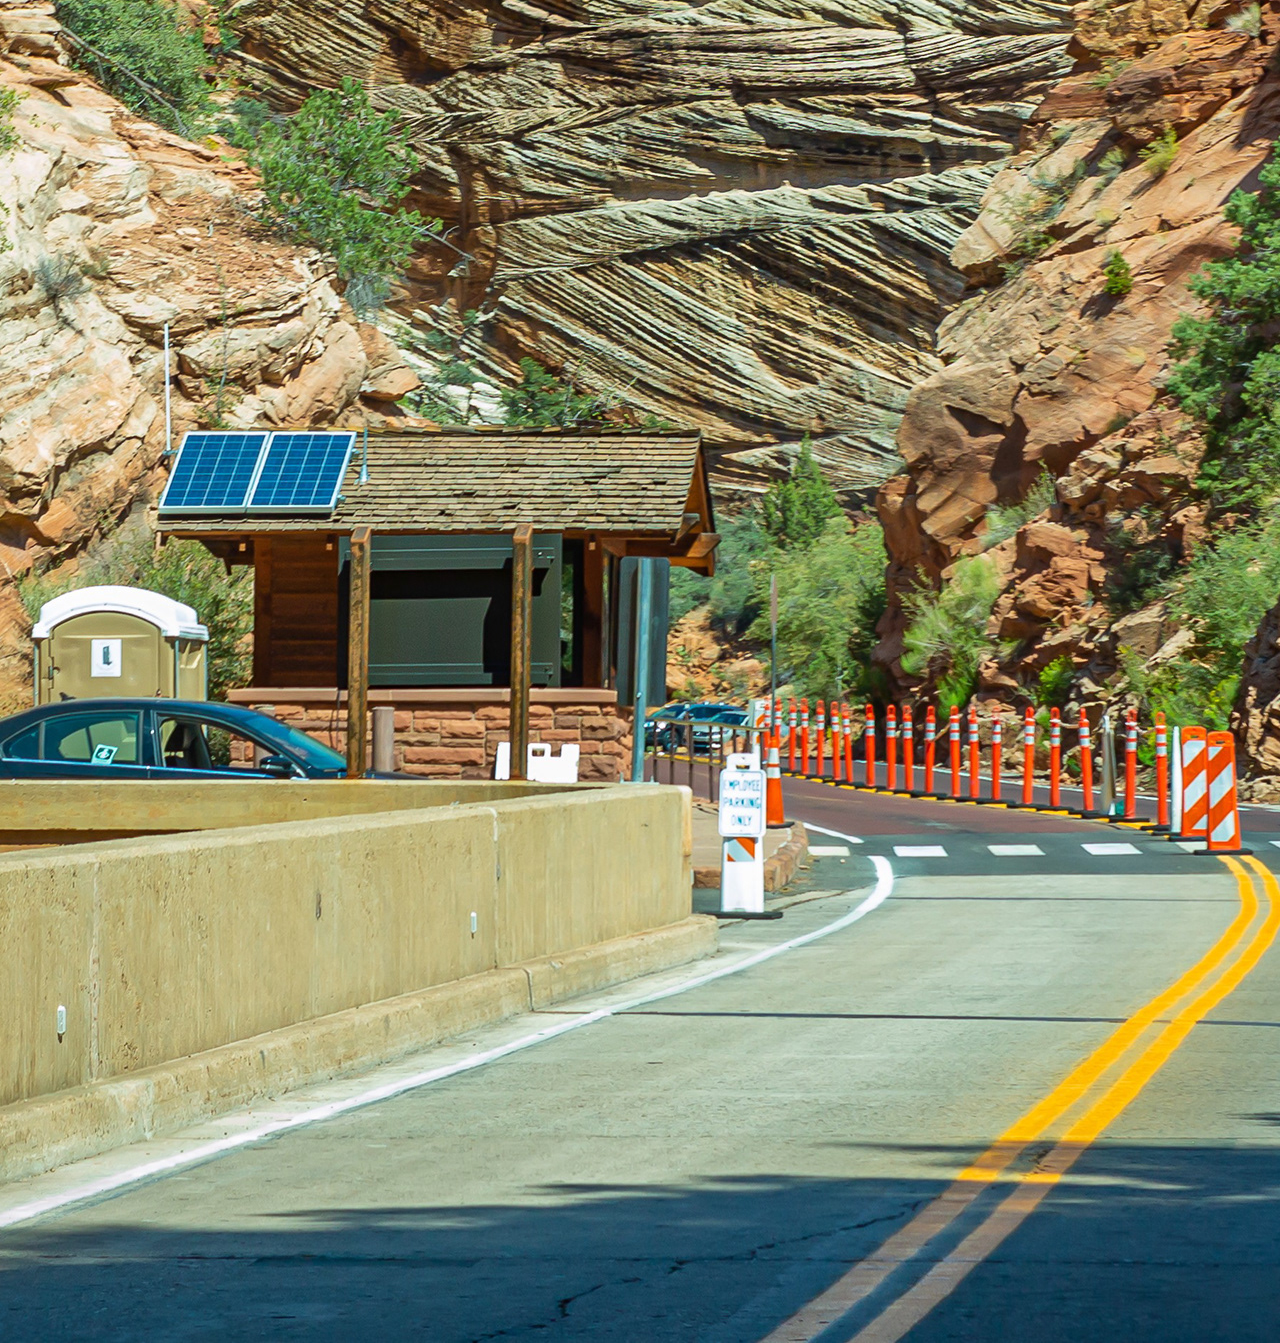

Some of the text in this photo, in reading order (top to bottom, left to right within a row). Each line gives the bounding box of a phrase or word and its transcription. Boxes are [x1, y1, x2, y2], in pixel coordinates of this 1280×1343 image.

[724, 779, 760, 791] EMPLOYEE
[724, 797, 761, 809] PARKING
[731, 814, 752, 826] ONLY
